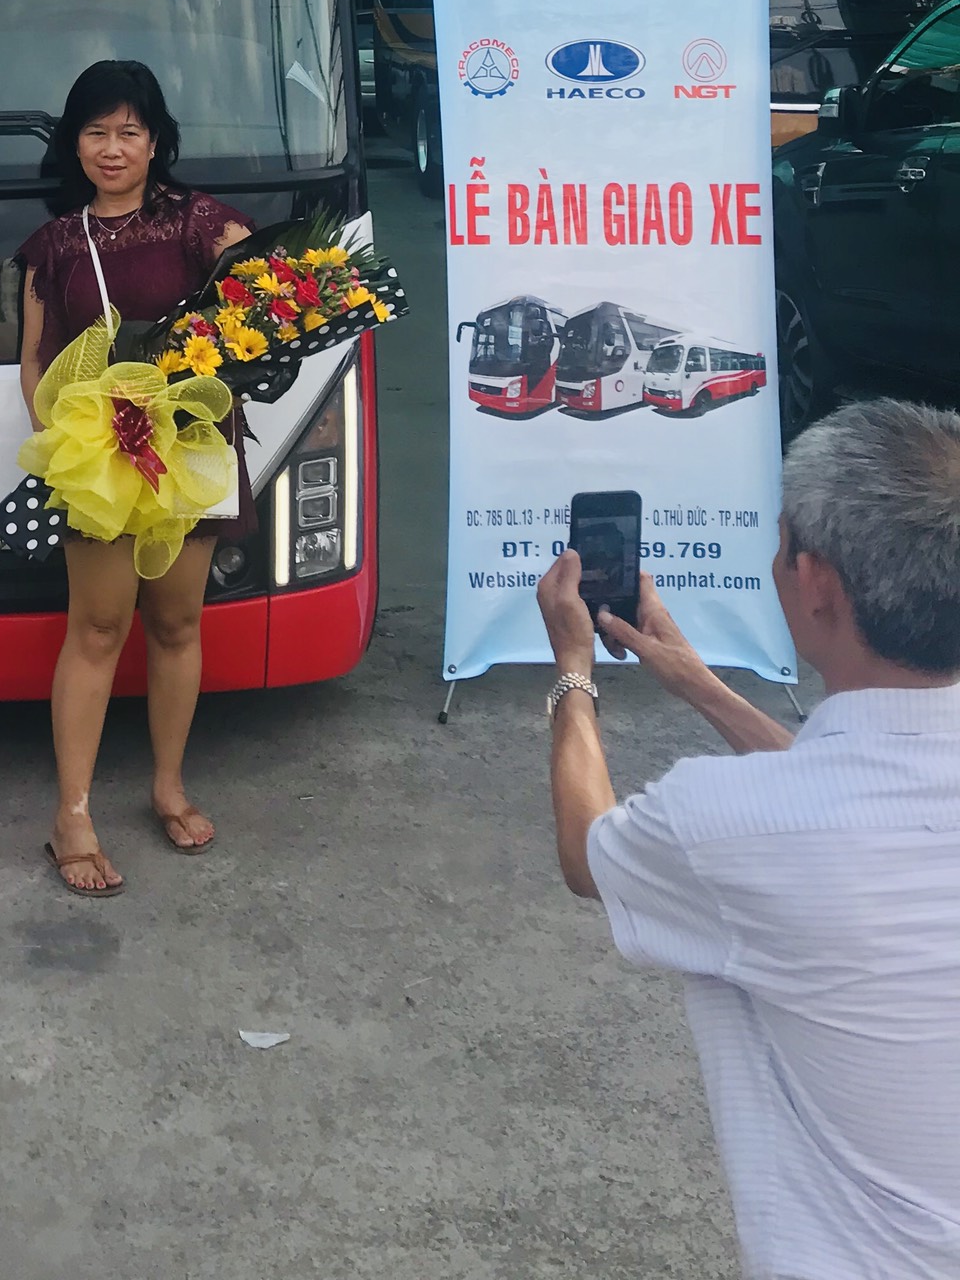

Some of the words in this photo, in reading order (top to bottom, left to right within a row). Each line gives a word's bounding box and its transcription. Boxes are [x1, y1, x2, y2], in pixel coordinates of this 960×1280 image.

[458, 38, 520, 80] TRACOMECO
[546, 87, 646, 100] HAECO
[673, 85, 737, 99] NGT
[448, 156, 491, 246] LỄ
[507, 167, 588, 246] BÀN
[603, 182, 693, 246] GIAO
[709, 183, 763, 246] XE
[486, 510, 502, 526] 785
[506, 509, 533, 526] QL.13
[544, 504, 571, 528] P.HIỆ
[718, 510, 759, 528] TP.HCM
[502, 541, 540, 557] ĐT:
[651, 571, 761, 591] anphat.com
